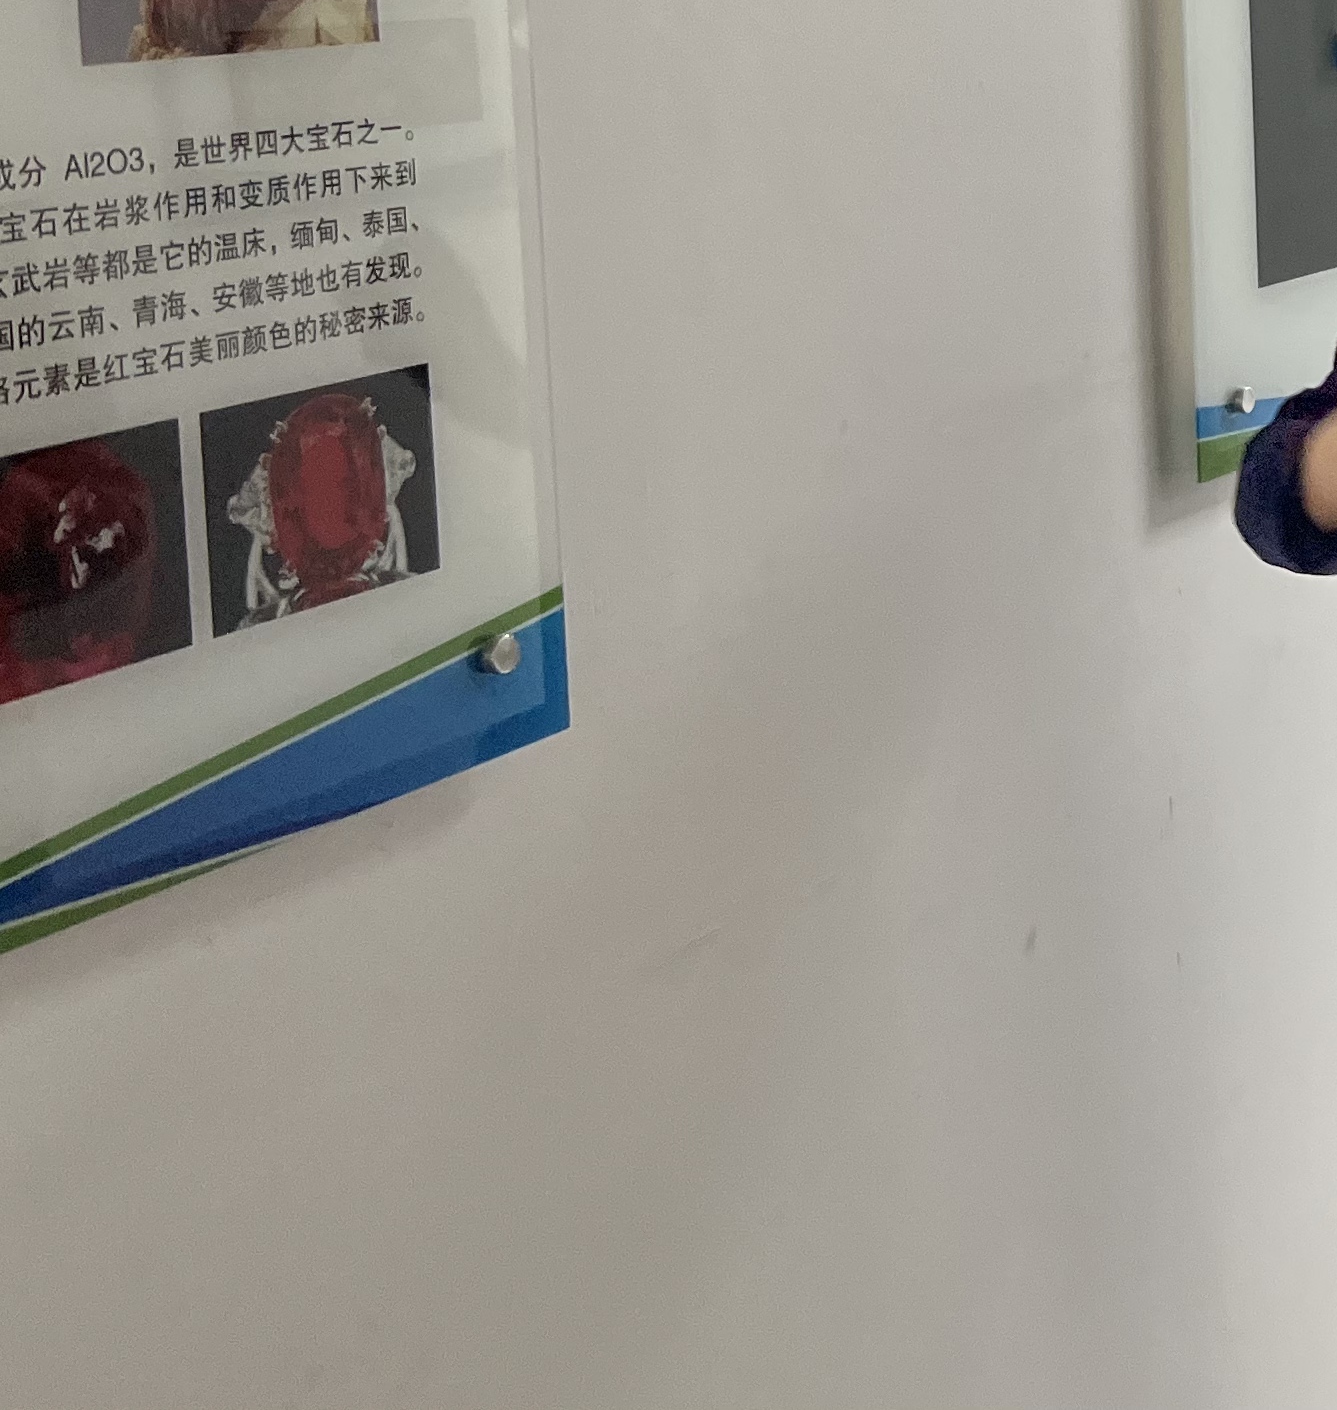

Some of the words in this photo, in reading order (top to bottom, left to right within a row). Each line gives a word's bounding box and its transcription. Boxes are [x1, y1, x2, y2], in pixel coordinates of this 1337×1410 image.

[0, 158, 416, 245] 宝石在岩浆作用和变质作用下来到
